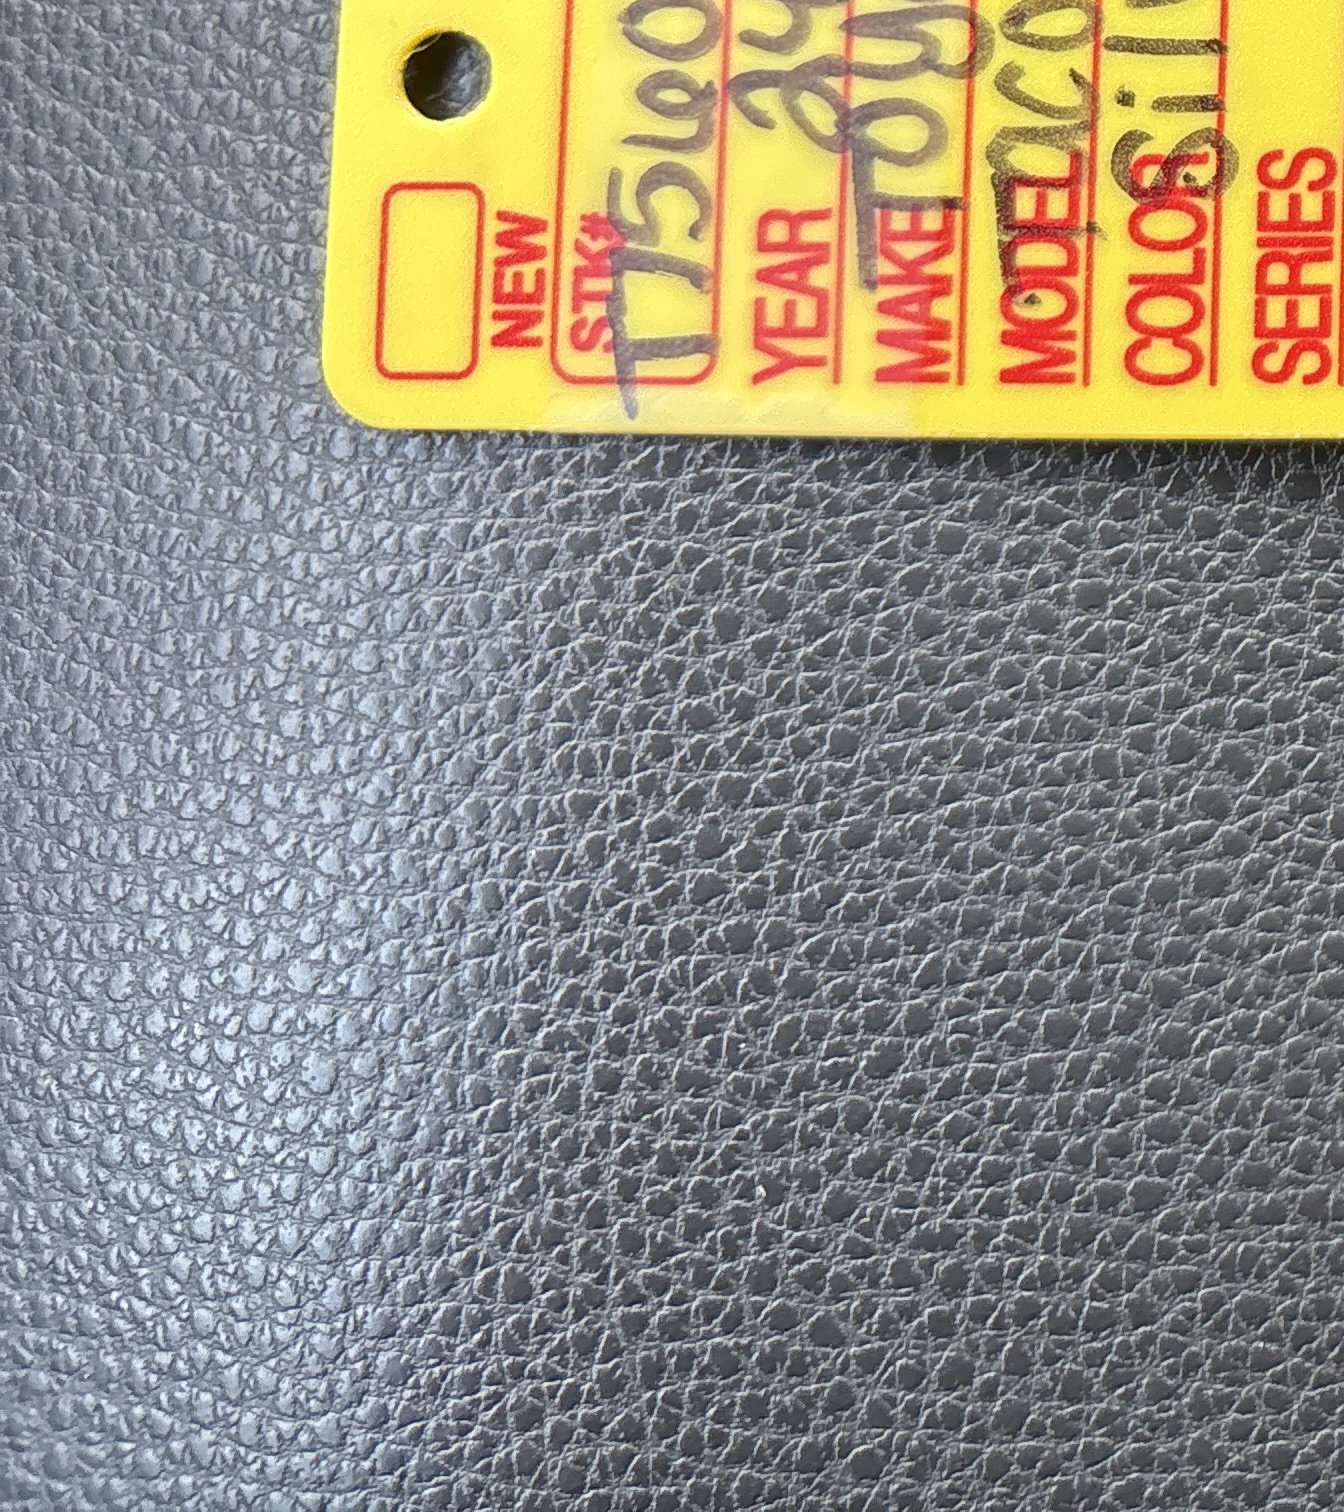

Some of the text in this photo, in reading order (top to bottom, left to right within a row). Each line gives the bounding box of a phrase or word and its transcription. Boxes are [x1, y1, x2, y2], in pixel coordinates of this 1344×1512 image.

[491, 210, 550, 348] NEW
[570, 212, 626, 353] STK#
[751, 207, 833, 386] YEAR
[874, 203, 956, 384] MAKE
[999, 149, 1083, 386] MODEL
[1123, 152, 1210, 387] COLOR
[1252, 147, 1338, 386] SERIES
